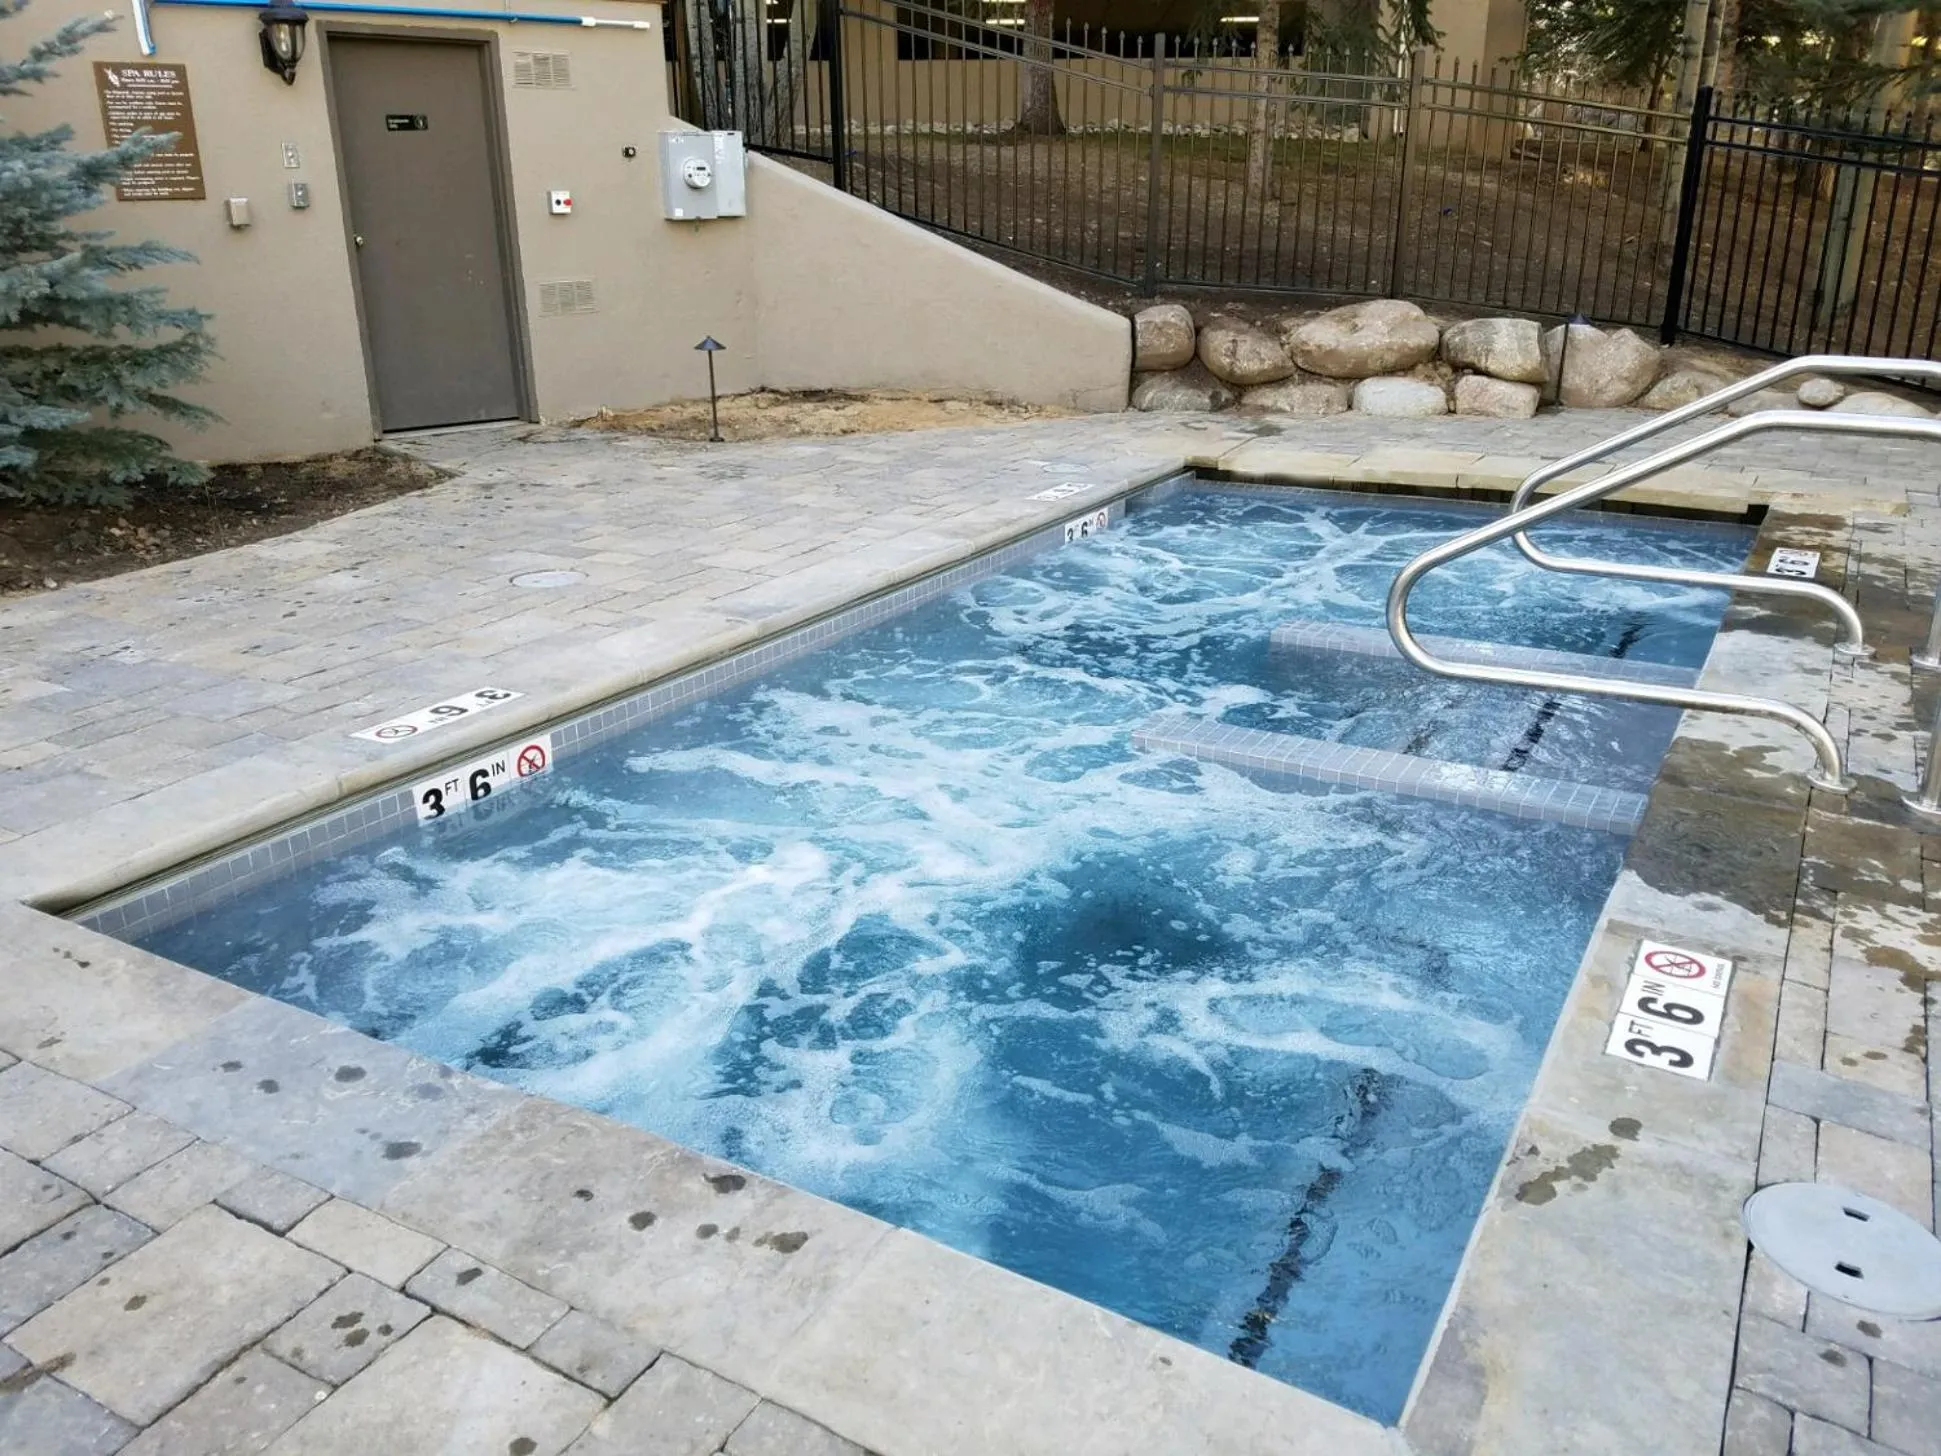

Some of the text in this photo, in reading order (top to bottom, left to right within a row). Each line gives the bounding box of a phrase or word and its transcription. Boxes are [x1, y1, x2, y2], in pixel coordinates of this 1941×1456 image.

[121, 69, 177, 78] SPA RULES
[474, 689, 511, 700] 3
[429, 705, 469, 717] 6
[422, 760, 506, 820] 3 FT 6 IN
[1624, 979, 1705, 1069] 3 FT 6 IN
